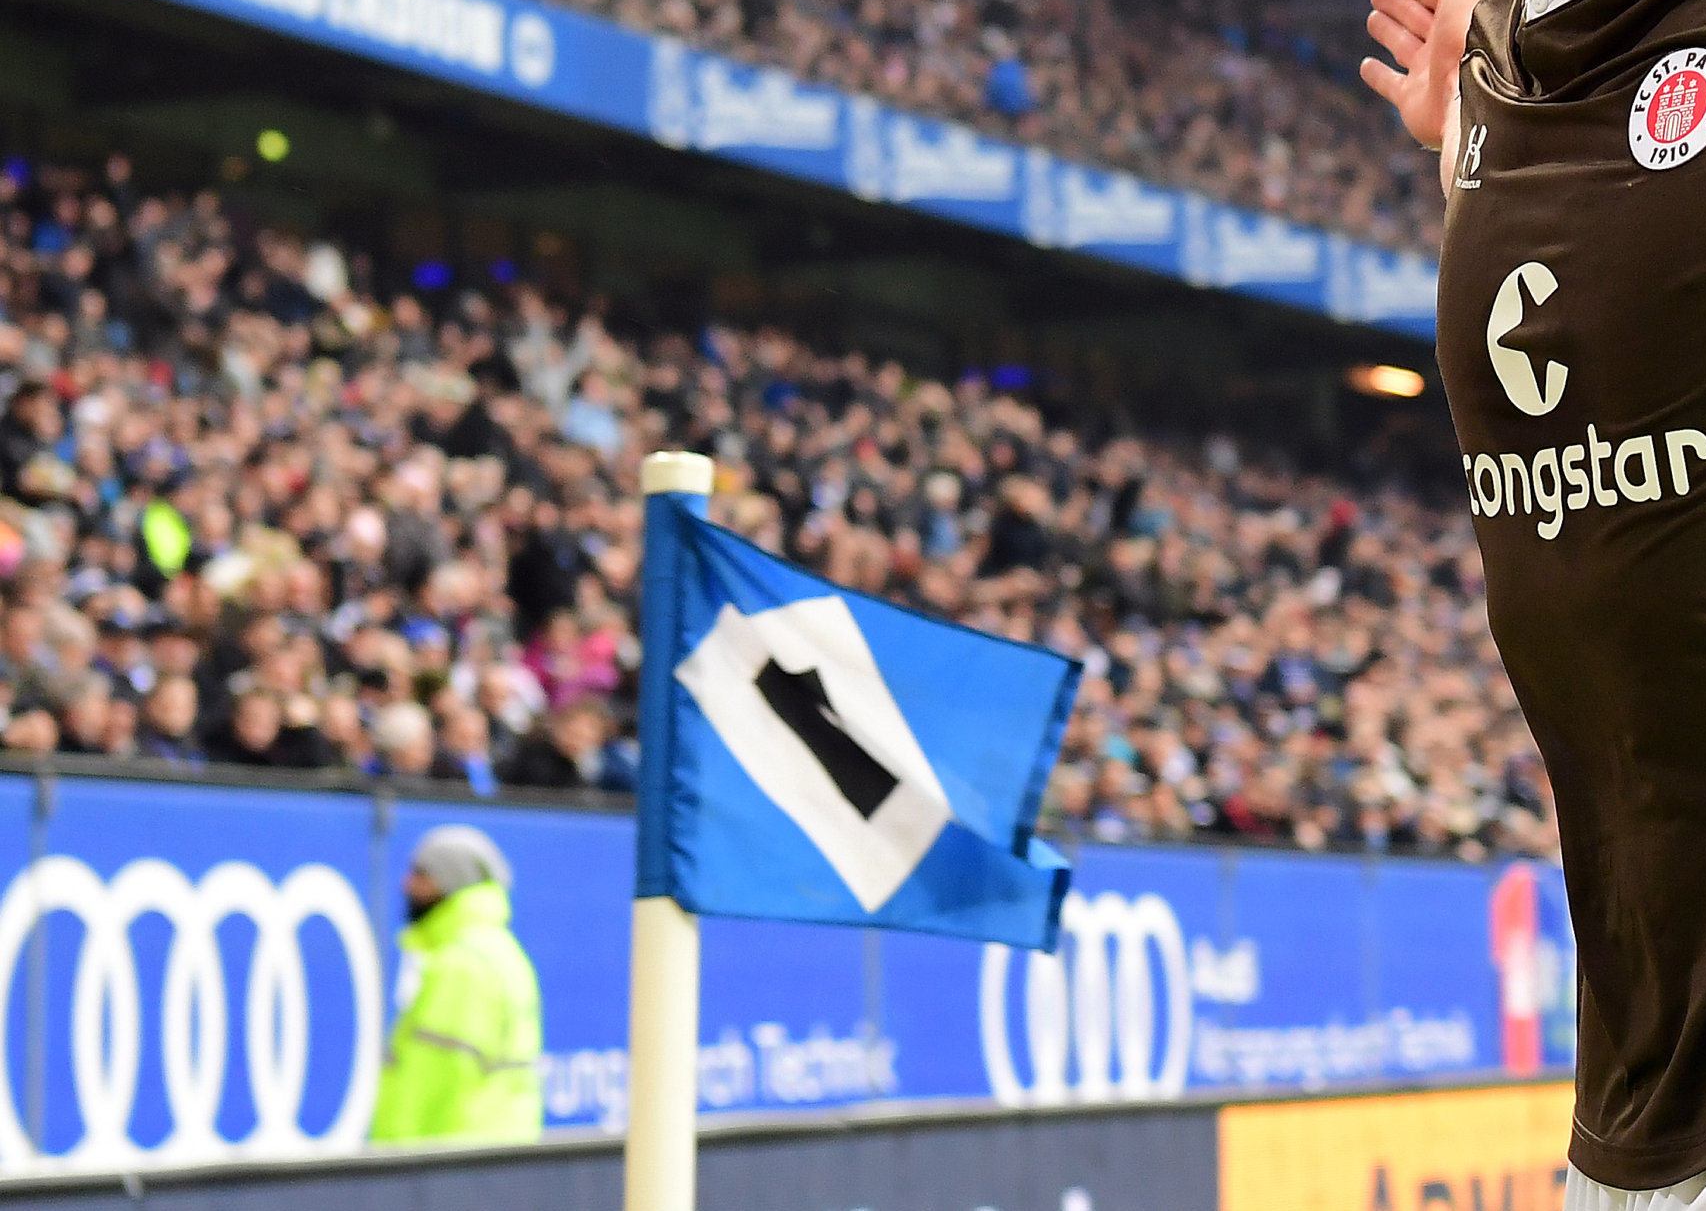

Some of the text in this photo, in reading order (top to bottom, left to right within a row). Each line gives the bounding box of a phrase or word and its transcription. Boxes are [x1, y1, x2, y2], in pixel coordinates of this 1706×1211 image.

[1634, 89, 1651, 113] FC
[1652, 59, 1678, 84] ST.
[1649, 142, 1690, 164] 1910
